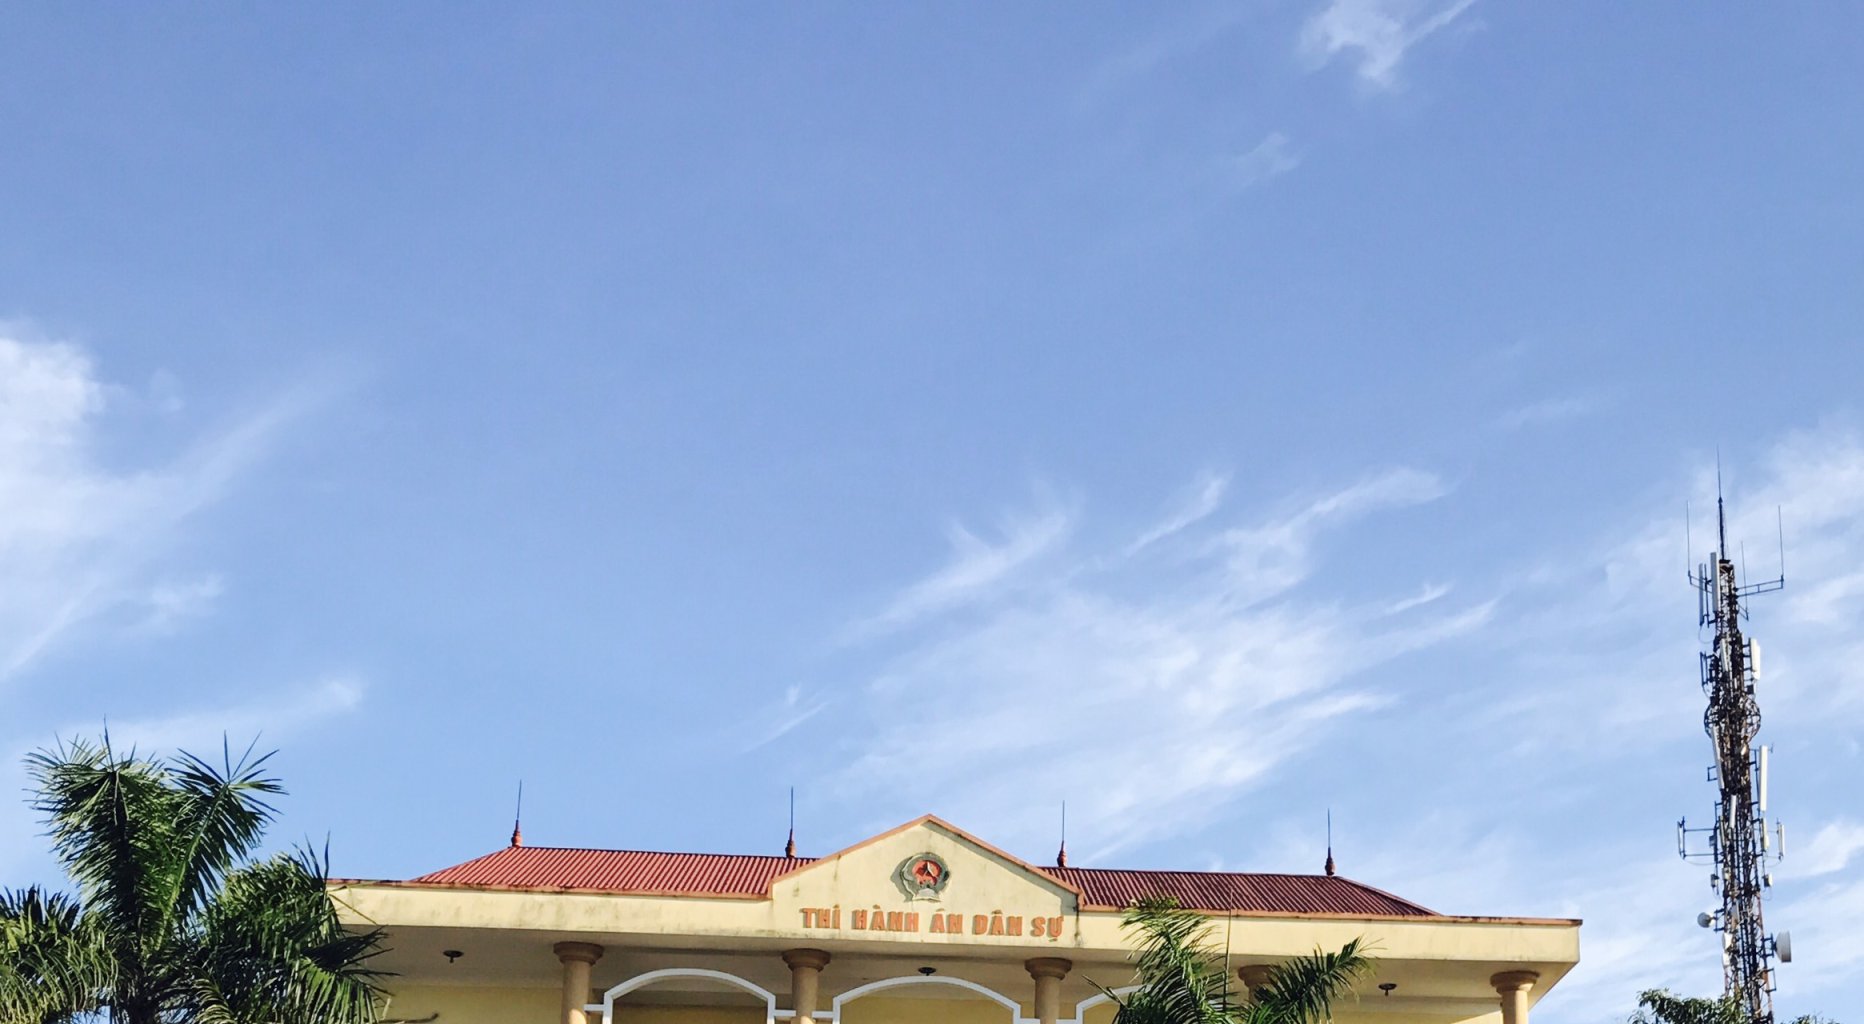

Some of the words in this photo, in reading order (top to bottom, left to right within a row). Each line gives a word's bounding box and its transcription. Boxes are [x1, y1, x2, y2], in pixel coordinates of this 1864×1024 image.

[852, 904, 919, 932] HÀNH
[929, 908, 963, 934] ÁN
[972, 909, 1023, 937] DÂN
[1031, 915, 1064, 942] SỰ
